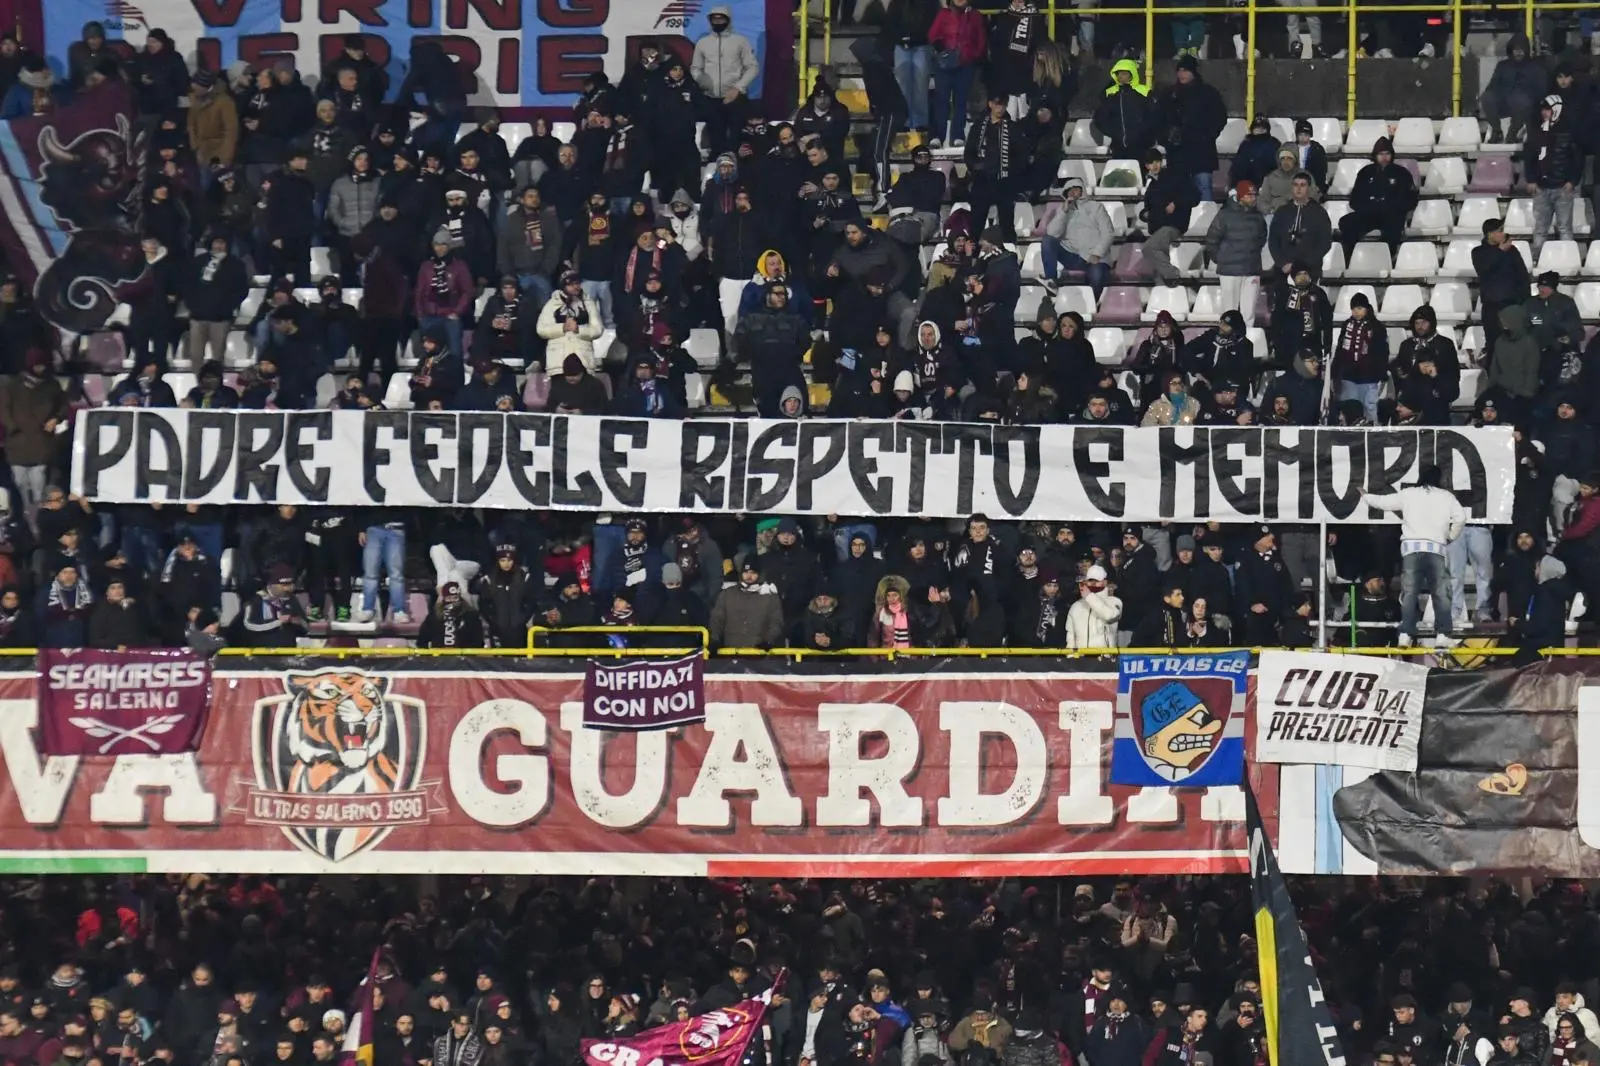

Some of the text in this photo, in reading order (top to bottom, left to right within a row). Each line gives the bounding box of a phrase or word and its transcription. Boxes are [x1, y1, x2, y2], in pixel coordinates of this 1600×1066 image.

[83, 410, 1488, 521] PADRE FEDELE RISPETTO E MEMORIA
[49, 660, 206, 692] SEAHORSES
[595, 662, 694, 691] DIFFIDATI
[1123, 658, 1213, 676] ULTRAS
[73, 691, 180, 710] SALERNO
[593, 690, 696, 717] CON NOI
[1274, 668, 1412, 717] CLUB DAL
[1266, 711, 1409, 748] PRESIDENTE
[449, 697, 1247, 829] GUARDI
[254, 796, 423, 822] ULTRAS SALERNO 1990
